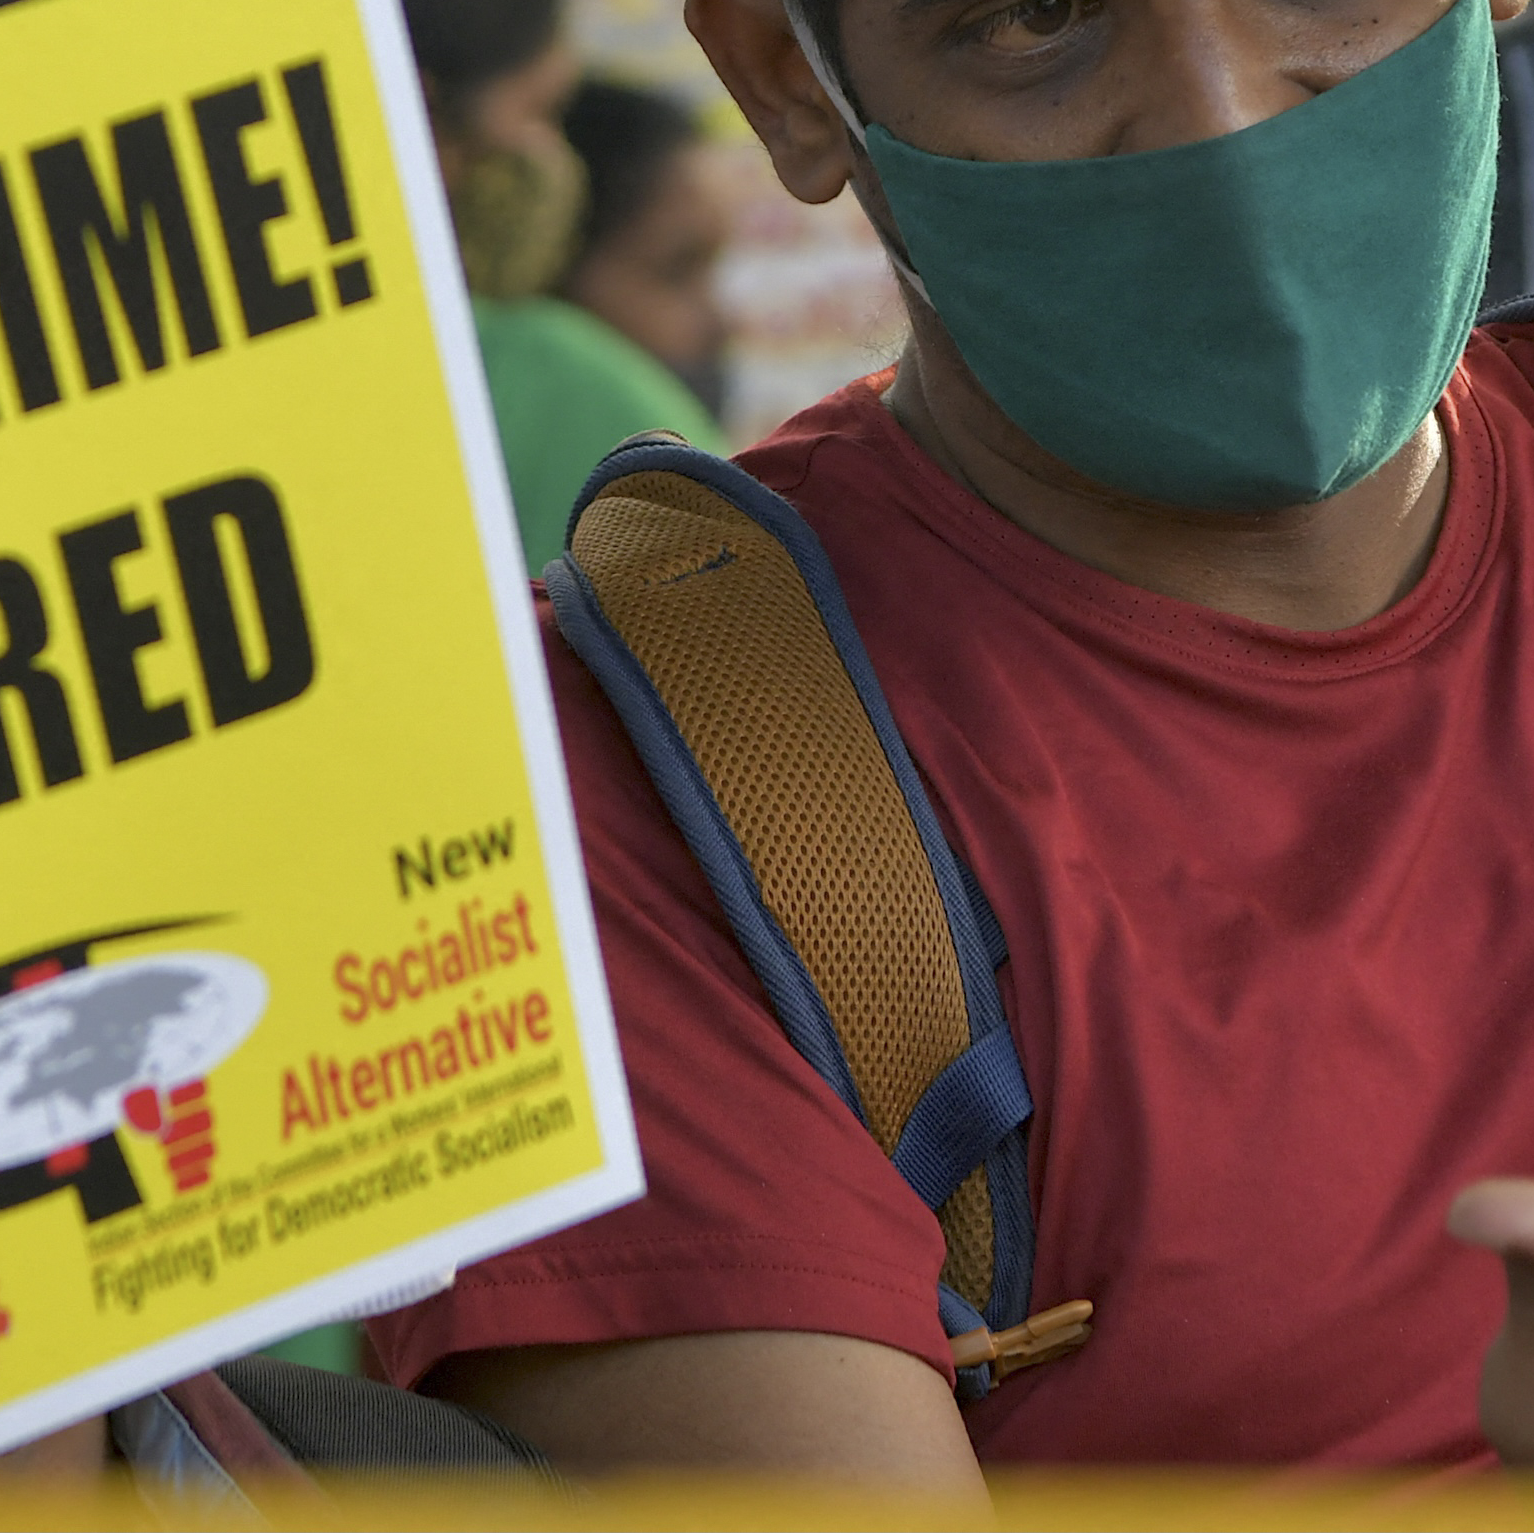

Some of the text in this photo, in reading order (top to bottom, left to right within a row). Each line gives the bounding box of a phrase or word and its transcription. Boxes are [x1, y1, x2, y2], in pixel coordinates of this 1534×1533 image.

[392, 817, 516, 900] New
[333, 891, 538, 1022] Socialist
[276, 987, 553, 1141] Alternative
[90, 1093, 577, 1314] Fighting for Democratic Socialism
